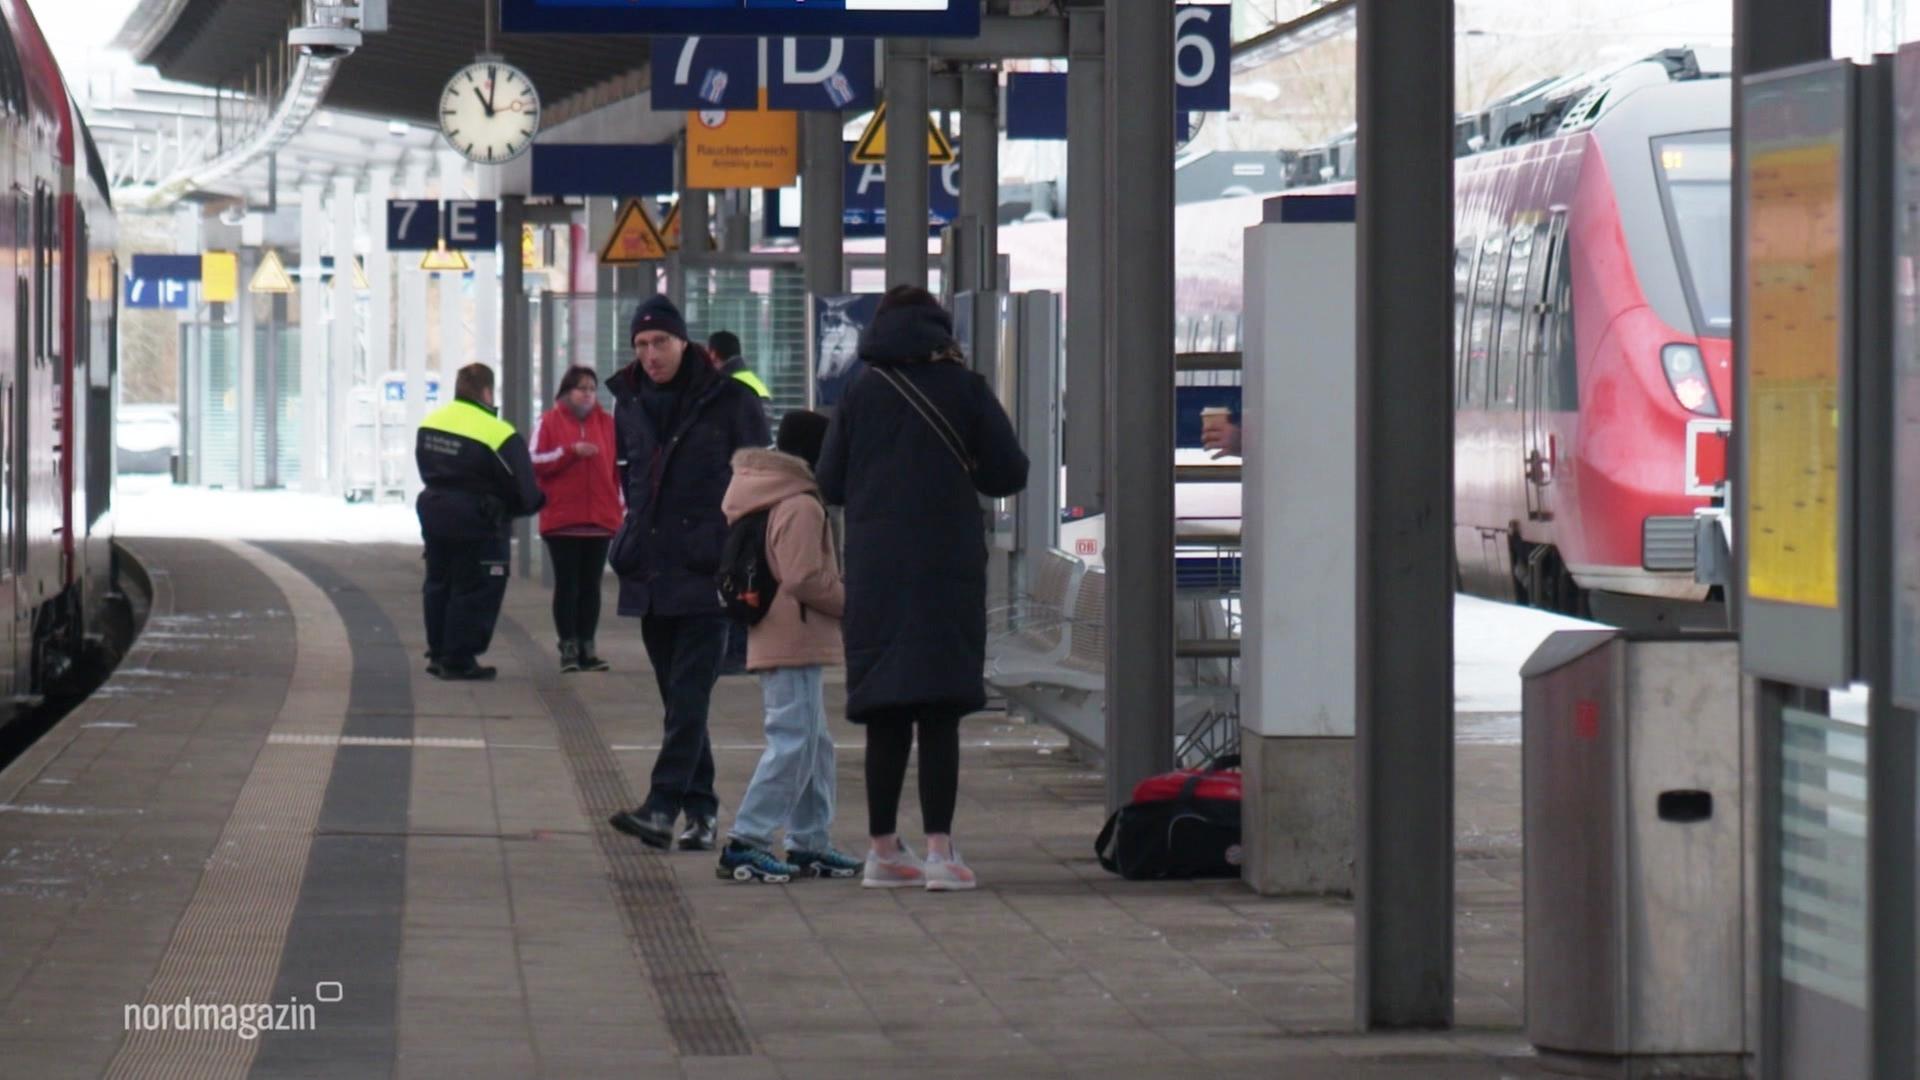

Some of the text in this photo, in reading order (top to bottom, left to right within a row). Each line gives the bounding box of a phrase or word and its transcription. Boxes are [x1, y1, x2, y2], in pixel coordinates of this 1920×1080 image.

[1174, 7, 1215, 87] 6
[393, 201, 477, 240] 7 E
[1077, 540, 1096, 554] DB
